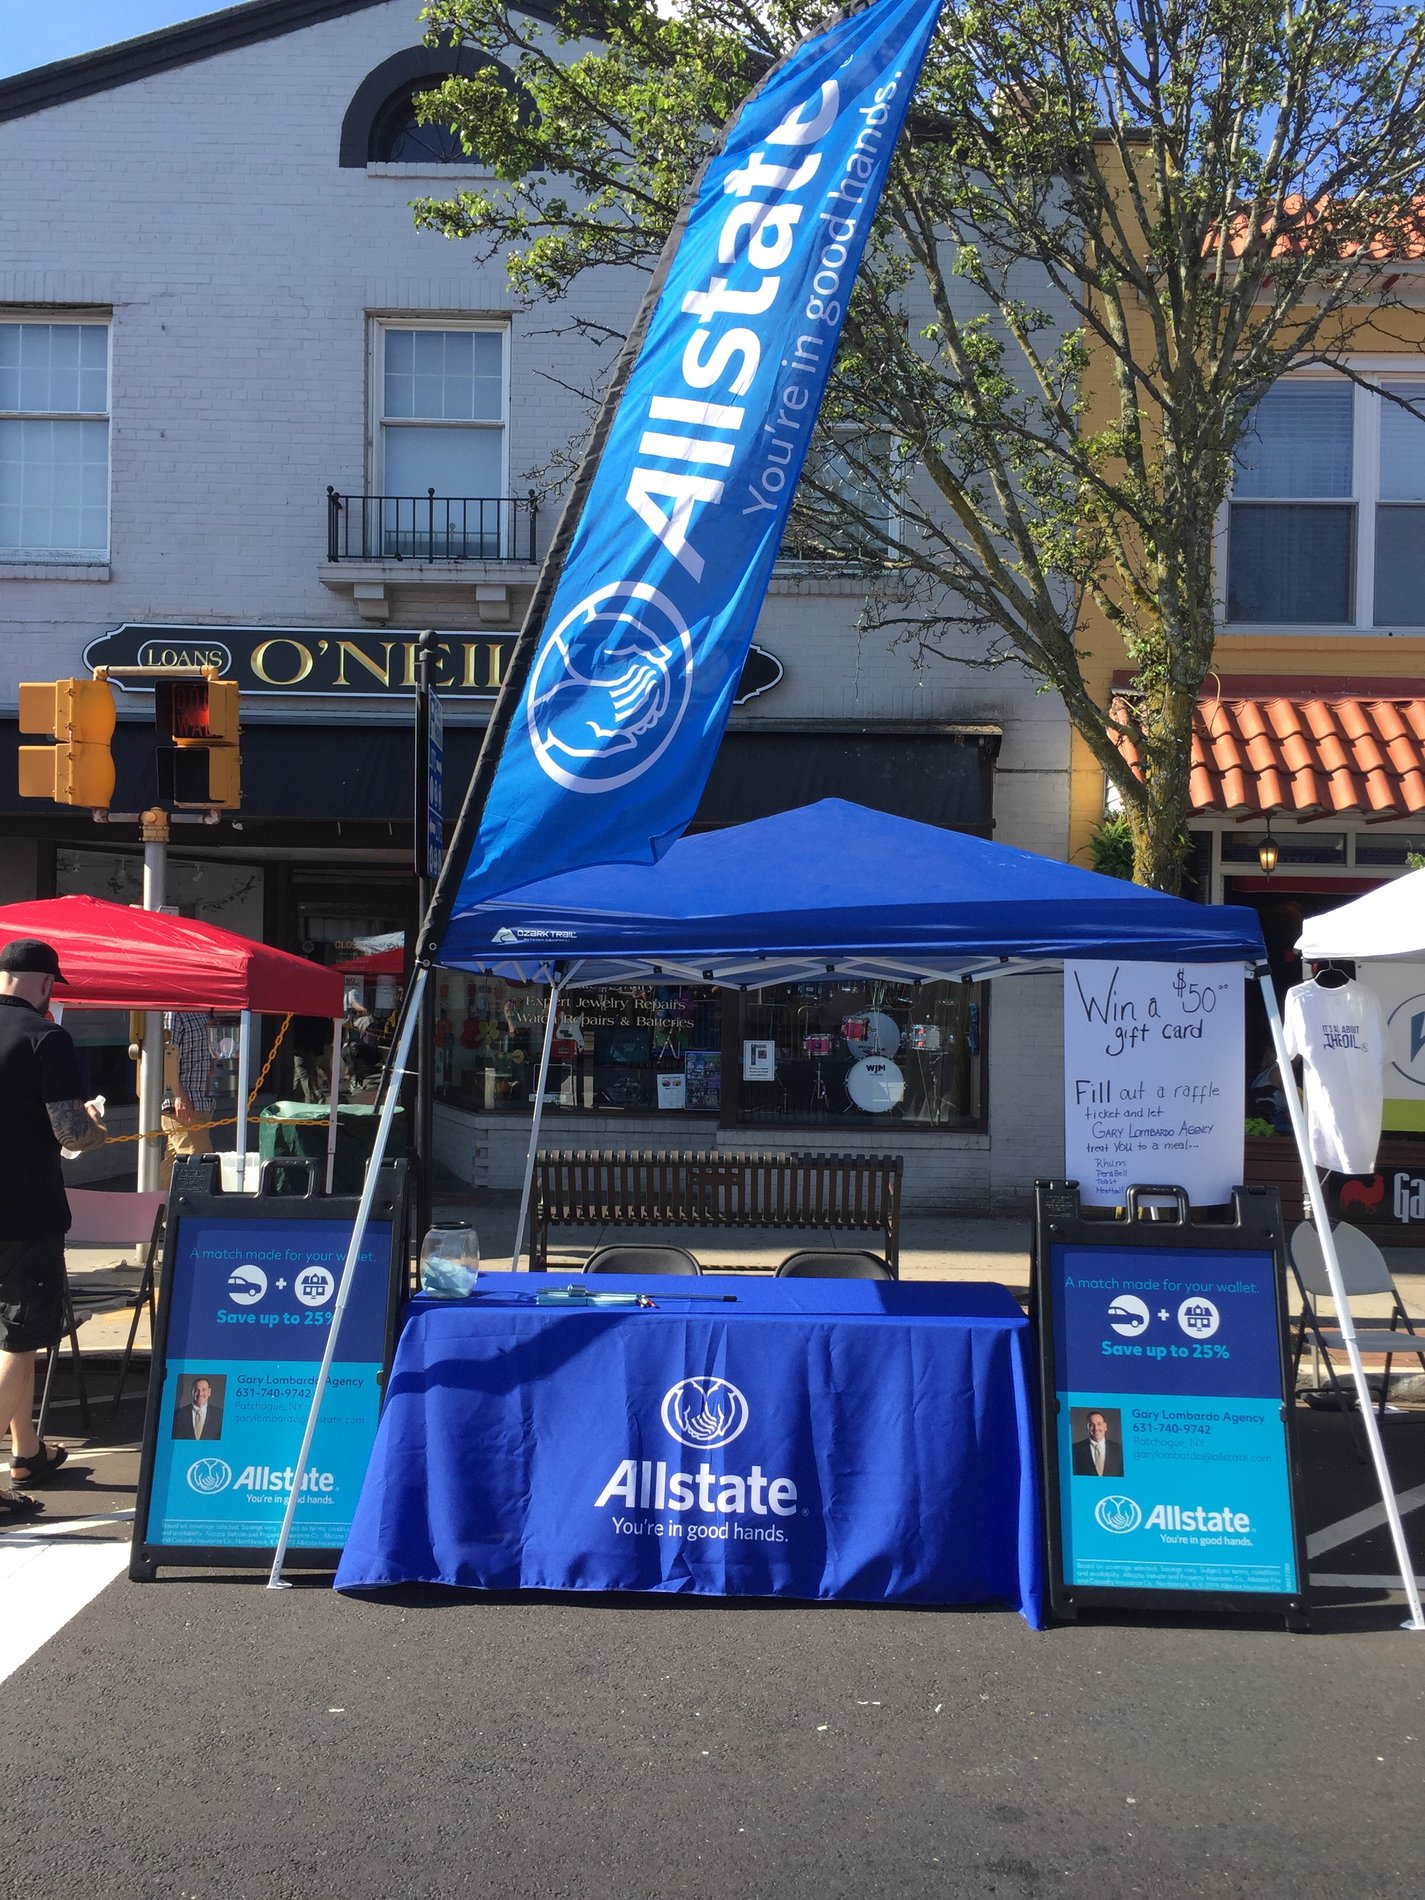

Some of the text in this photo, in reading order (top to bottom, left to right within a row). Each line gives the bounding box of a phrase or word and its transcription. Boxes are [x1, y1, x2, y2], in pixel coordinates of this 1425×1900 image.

[743, 70, 903, 515] You're in good hands.
[625, 79, 841, 585] Allstate
[147, 648, 222, 668] LOANS
[1073, 966, 1136, 1025] Win
[1147, 996, 1162, 1019] a
[575, 997, 630, 1010] Jewelry
[634, 999, 686, 1014] Repairs
[516, 1013, 695, 1029] Watc Repairs & Batteries
[1105, 1018, 1203, 1057] gift card
[1075, 1079, 1221, 1105] Fill out a raffle
[1085, 1106, 1164, 1120] ticket and let
[1091, 1121, 1124, 1139] GARY
[1086, 1142, 1109, 1153] treat
[1138, 1142, 1148, 1151] to
[1151, 1142, 1159, 1150] a
[189, 1248, 377, 1264] A match made for your wlet.
[1064, 1276, 1260, 1295] A match made for your wallet.
[216, 1309, 256, 1325] Save
[259, 1312, 280, 1328] up
[282, 1311, 300, 1325] to
[1101, 1340, 1230, 1361] Save up to 25%
[237, 1374, 263, 1386] Gary
[326, 1376, 364, 1388] Agency
[235, 1388, 311, 1398] 631-740-9742
[1132, 1408, 1265, 1424] Gary Lombardo Agency
[1132, 1422, 1211, 1434] 631-740-9742
[593, 1459, 798, 1517] Allstate
[246, 1494, 272, 1504] You're
[274, 1494, 282, 1503] in
[1144, 1504, 1251, 1532] Allstate
[611, 1516, 789, 1543] You're in good hands.
[1160, 1533, 1254, 1547] You're in good hands.
